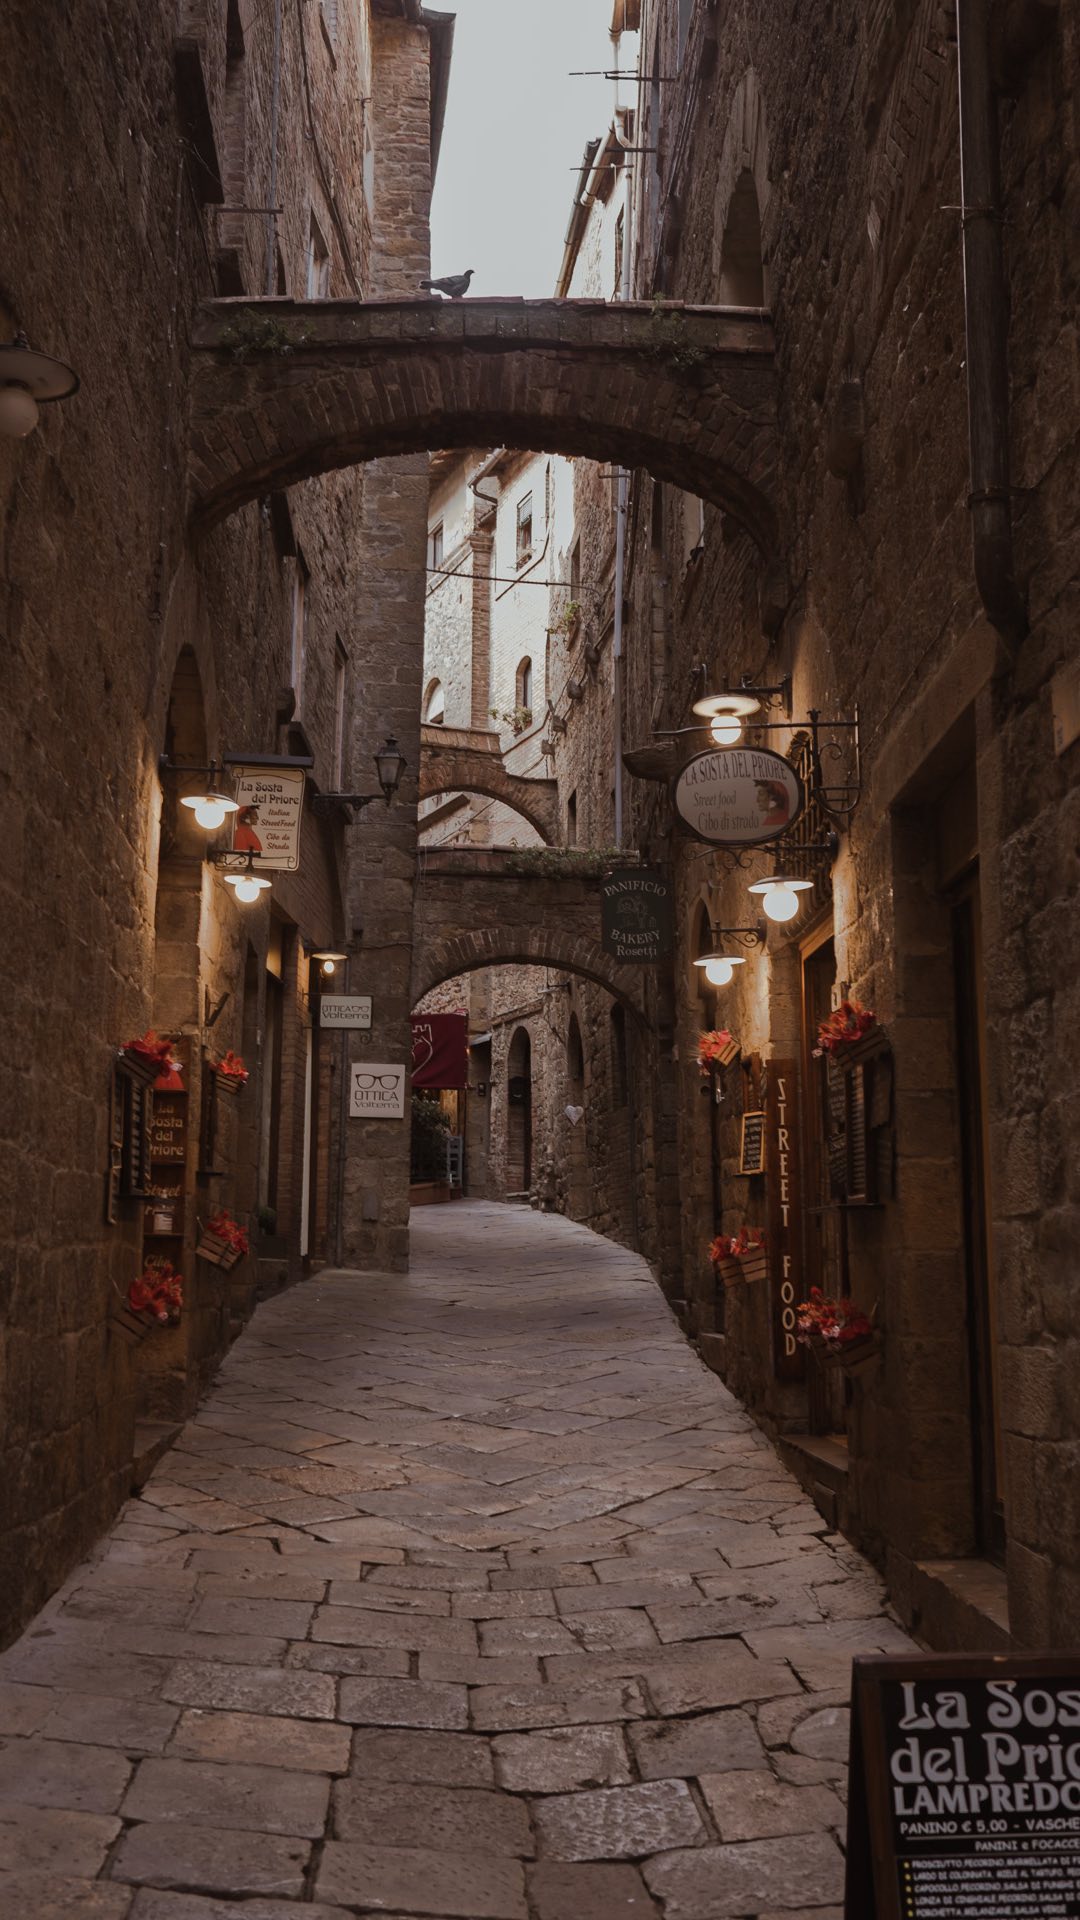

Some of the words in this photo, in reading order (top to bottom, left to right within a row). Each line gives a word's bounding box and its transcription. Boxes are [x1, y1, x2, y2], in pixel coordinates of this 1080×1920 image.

[699, 753, 730, 783] SOSTA
[730, 752, 751, 778] DEL
[751, 753, 788, 780] PRIORE
[241, 781, 253, 792] La
[255, 781, 283, 793] Sosta
[251, 794, 267, 804] del
[269, 794, 300, 805] Priore
[694, 792, 717, 806] Street
[718, 790, 737, 809] food
[698, 811, 720, 832] Cibo
[266, 832, 280, 841] Cibo
[266, 842, 290, 850] Strada
[604, 880, 667, 896] PANIFICIO
[610, 928, 660, 944] BAKERY
[616, 944, 657, 960] Rosetti
[321, 1012, 370, 1020] Volterra
[322, 1005, 351, 1013] OTTICA
[354, 1090, 399, 1101] OTTICA
[354, 1101, 401, 1110] Volterra
[155, 1130, 174, 1142] del
[777, 1078, 791, 1229] STREET
[781, 1255, 796, 1357] FOOD
[898, 1681, 971, 1730] La
[985, 1680, 1080, 1728] Sos
[891, 1737, 969, 1783] del
[900, 1821, 957, 1834] PANINO
[961, 1820, 972, 1833] €
[975, 1840, 1019, 1851] PANINI
